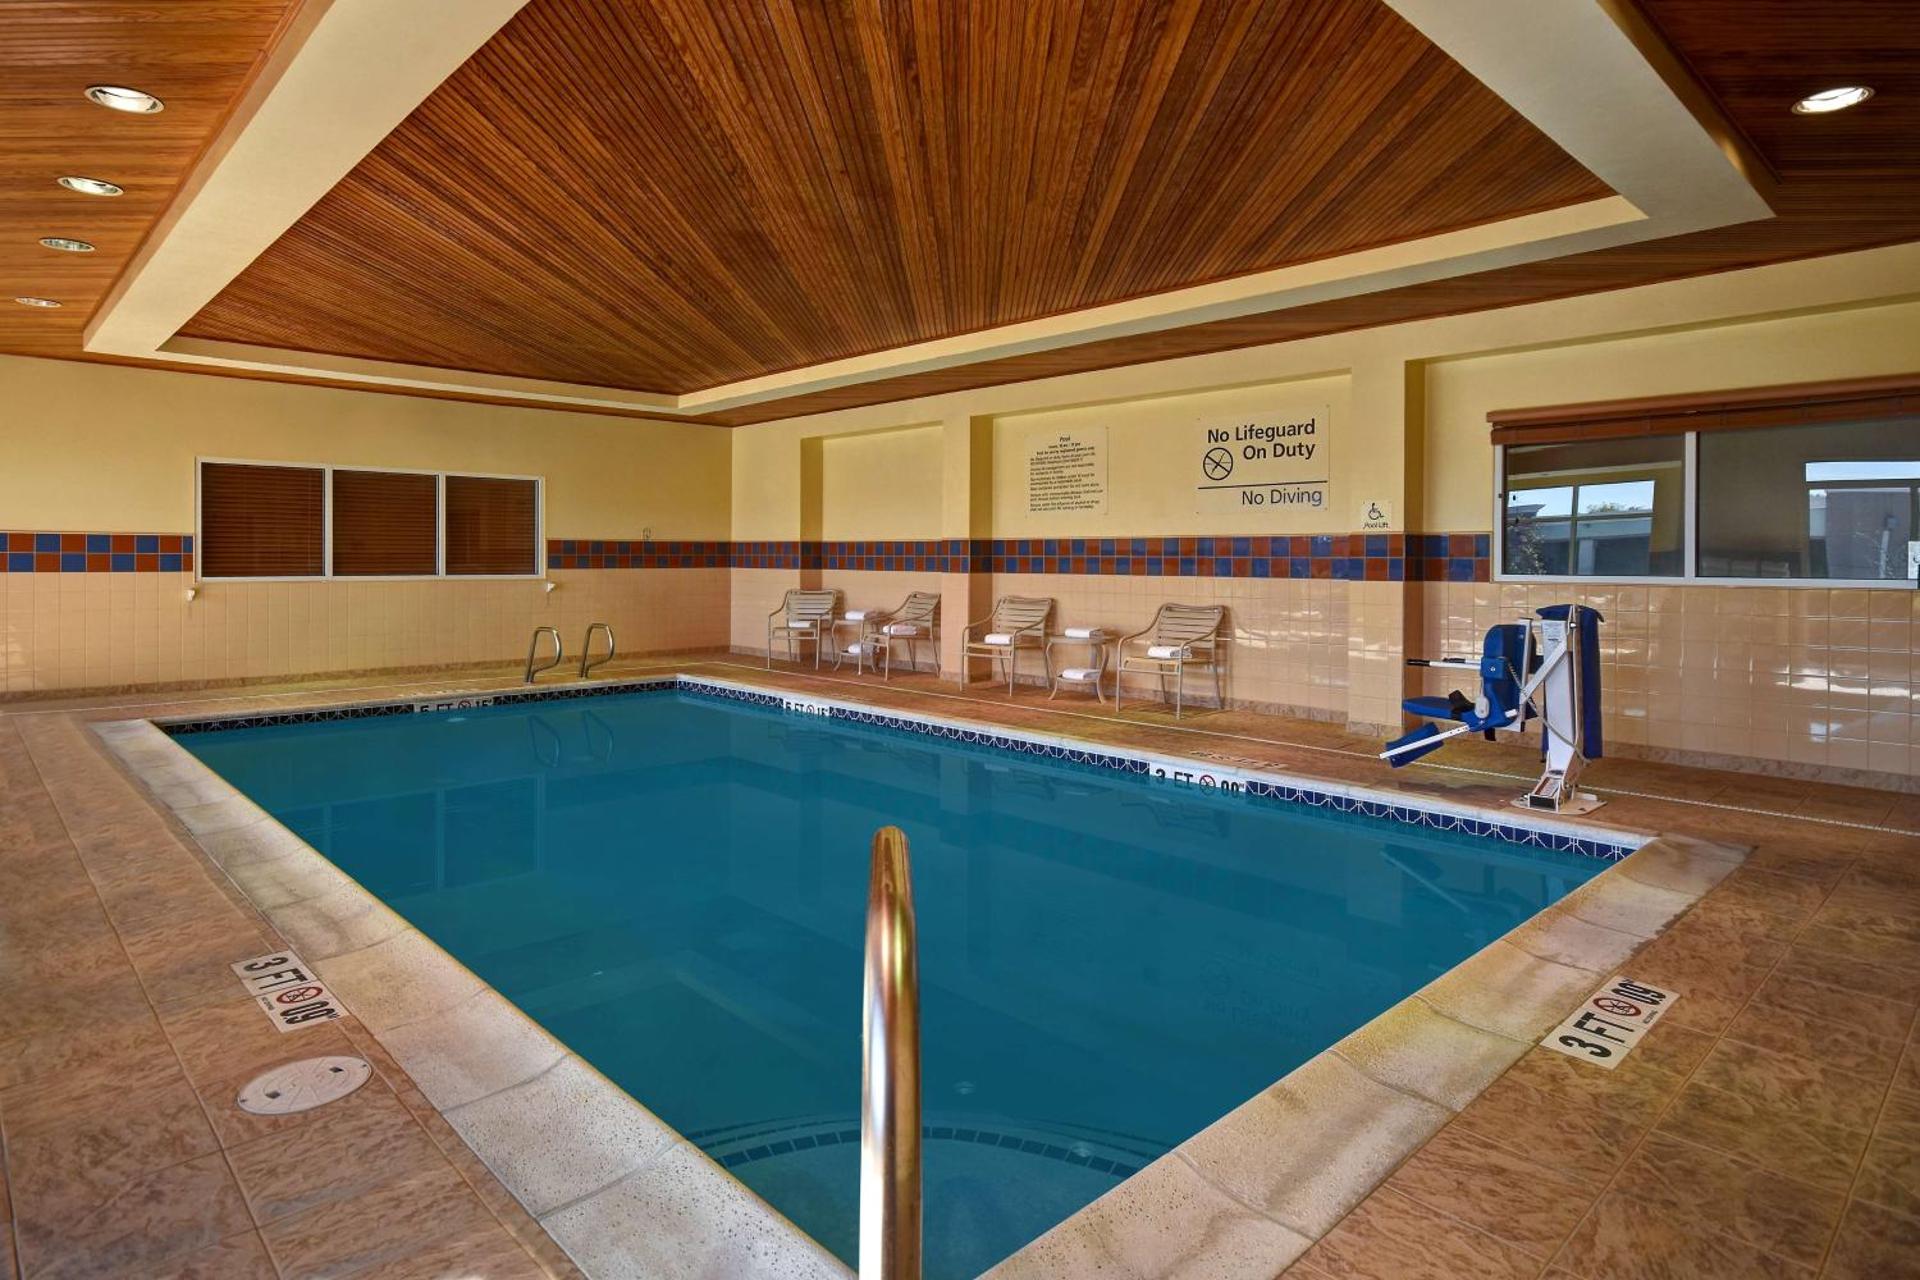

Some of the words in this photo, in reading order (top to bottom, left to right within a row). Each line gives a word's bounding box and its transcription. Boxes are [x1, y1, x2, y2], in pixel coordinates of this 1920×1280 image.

[1208, 429, 1229, 443] No
[1236, 418, 1316, 442] Lifeguard
[1243, 445, 1266, 460] On
[1273, 443, 1315, 460] Duty
[1242, 491, 1264, 505] No
[1270, 488, 1322, 506] Diving
[243, 955, 289, 973] 3
[251, 967, 309, 991] FT
[1572, 1010, 1635, 1044] FT
[1558, 1034, 1612, 1058] 3
